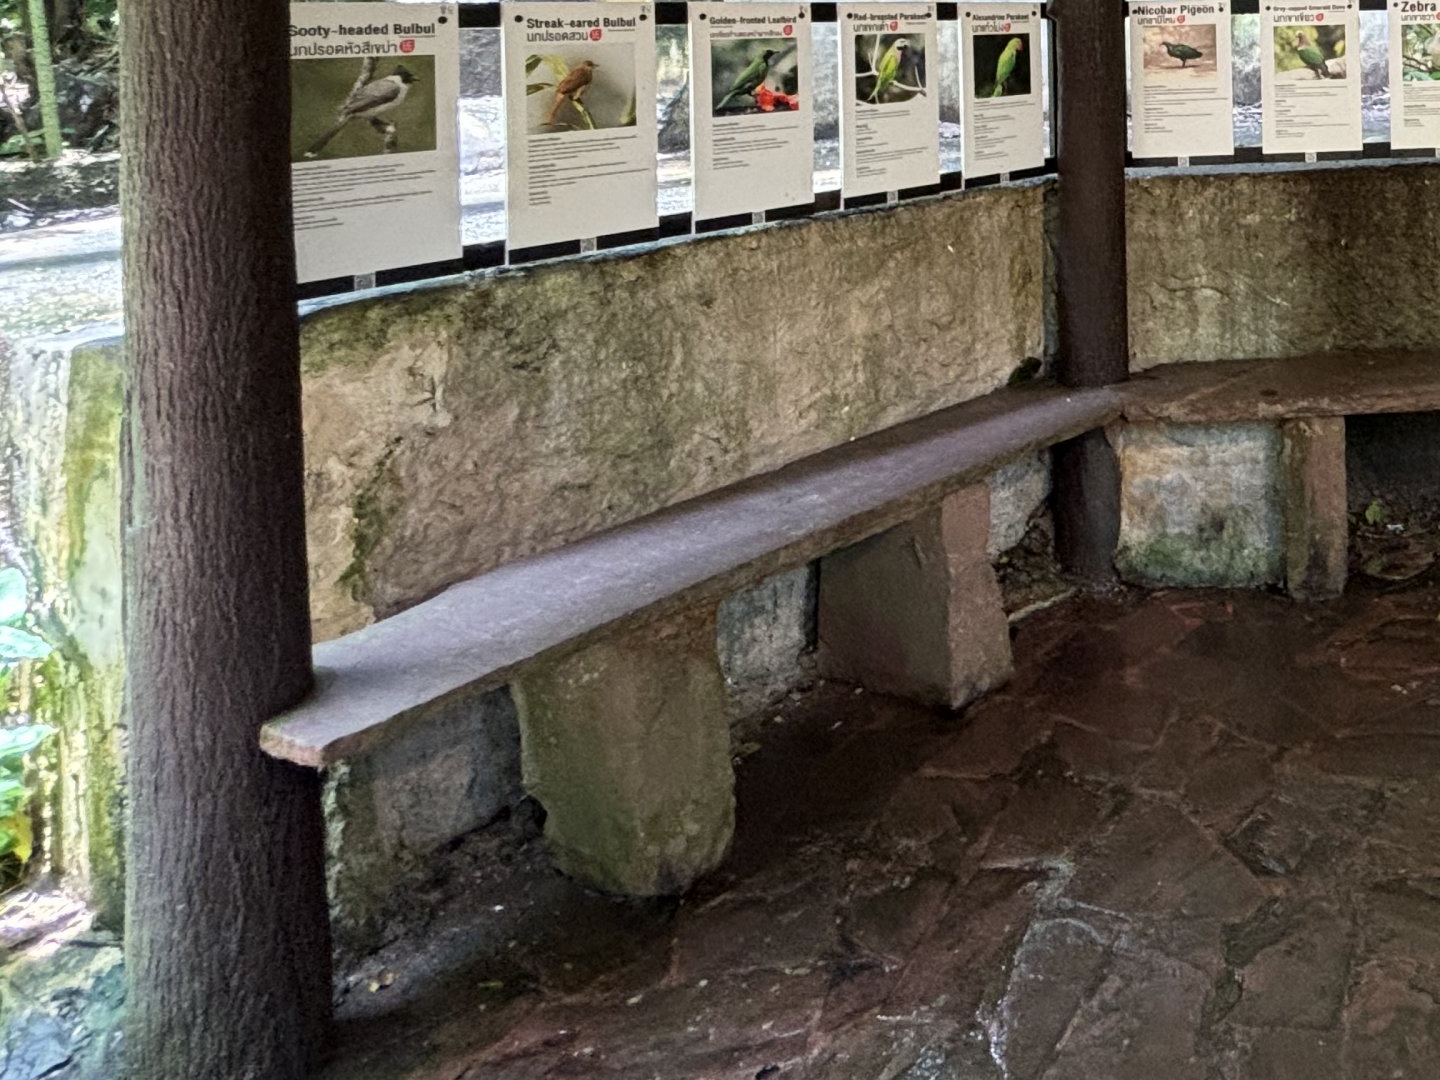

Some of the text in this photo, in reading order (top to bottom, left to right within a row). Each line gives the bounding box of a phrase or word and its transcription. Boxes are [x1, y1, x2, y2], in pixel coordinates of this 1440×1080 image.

[1137, 4, 1215, 16] Nicobar Pigeon
[1400, 0, 1437, 13] Zebra
[527, 17, 636, 29] Streak-eared Bulbul
[287, 22, 436, 39] Sooty-headed Bulbul
